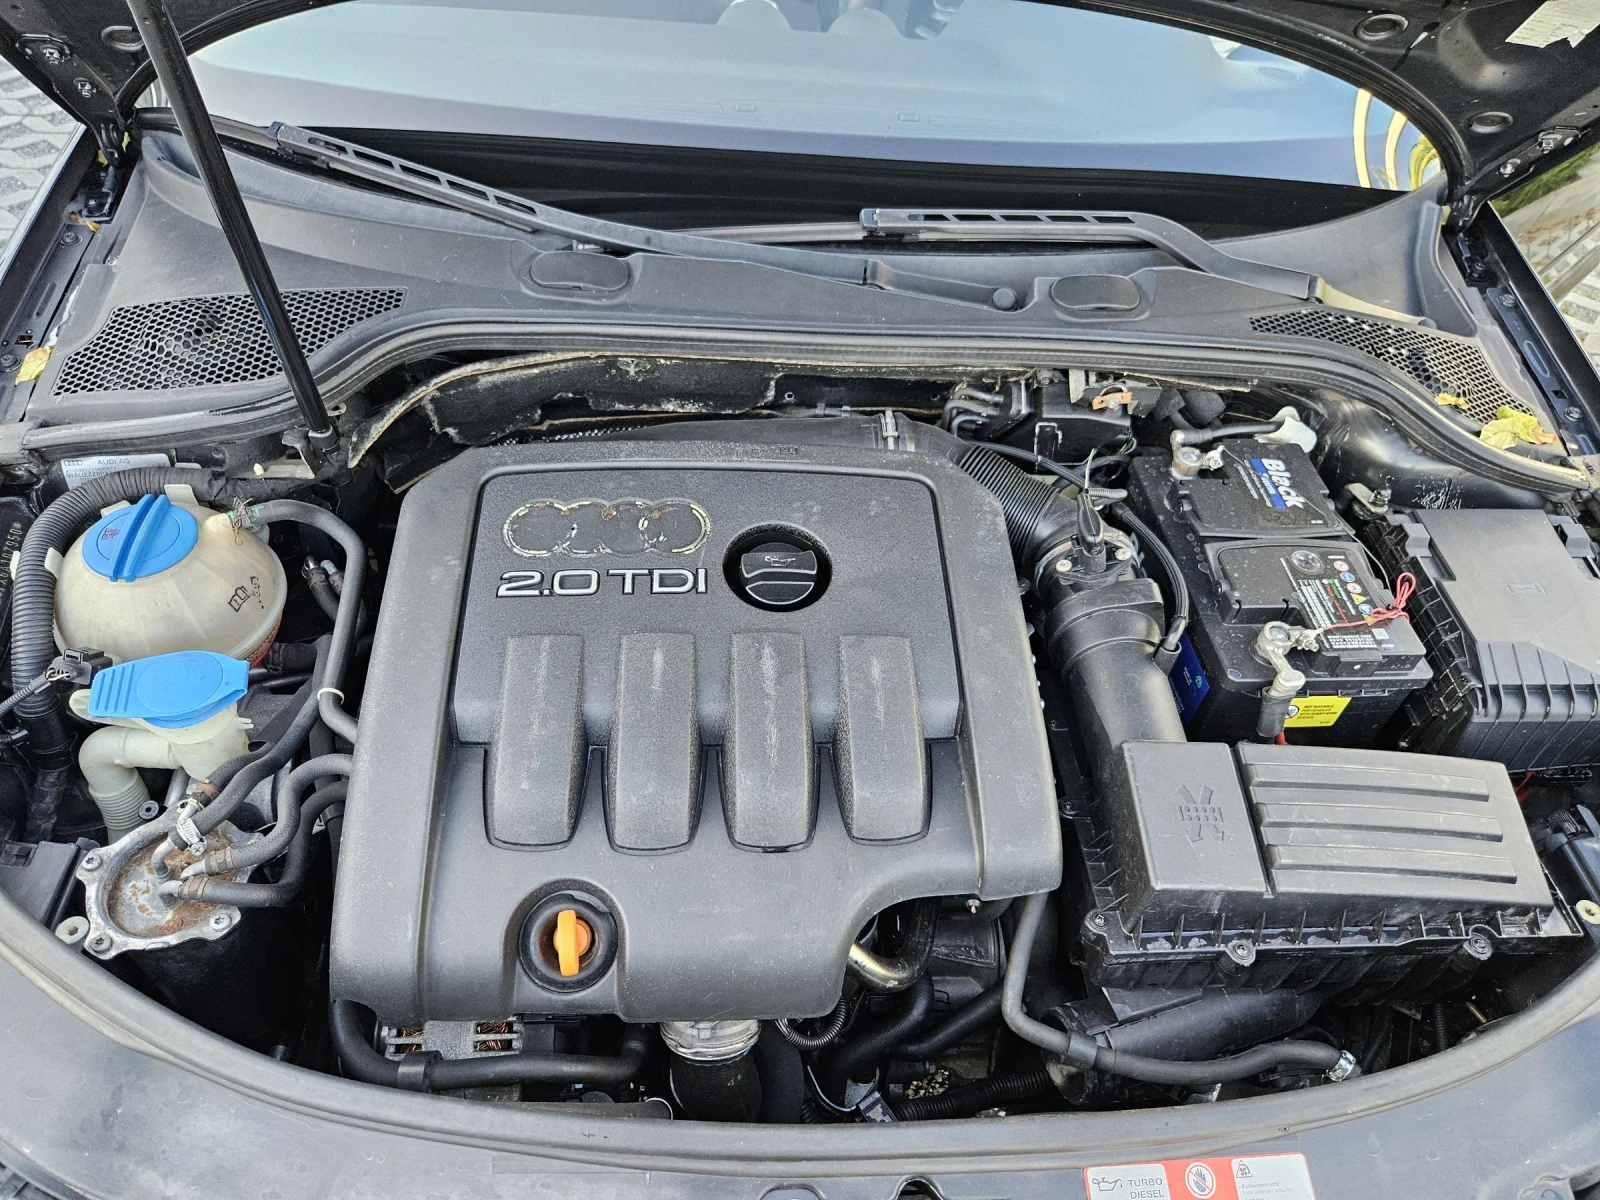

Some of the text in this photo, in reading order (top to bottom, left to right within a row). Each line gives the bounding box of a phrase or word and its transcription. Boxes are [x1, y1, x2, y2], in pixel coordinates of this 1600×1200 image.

[97, 457, 131, 466] AUDI AG
[1261, 457, 1306, 509] Black
[497, 567, 708, 598] 2.0 TDI
[1127, 1177, 1163, 1187] TURBO
[1130, 1189, 1165, 1199] DIESEL
